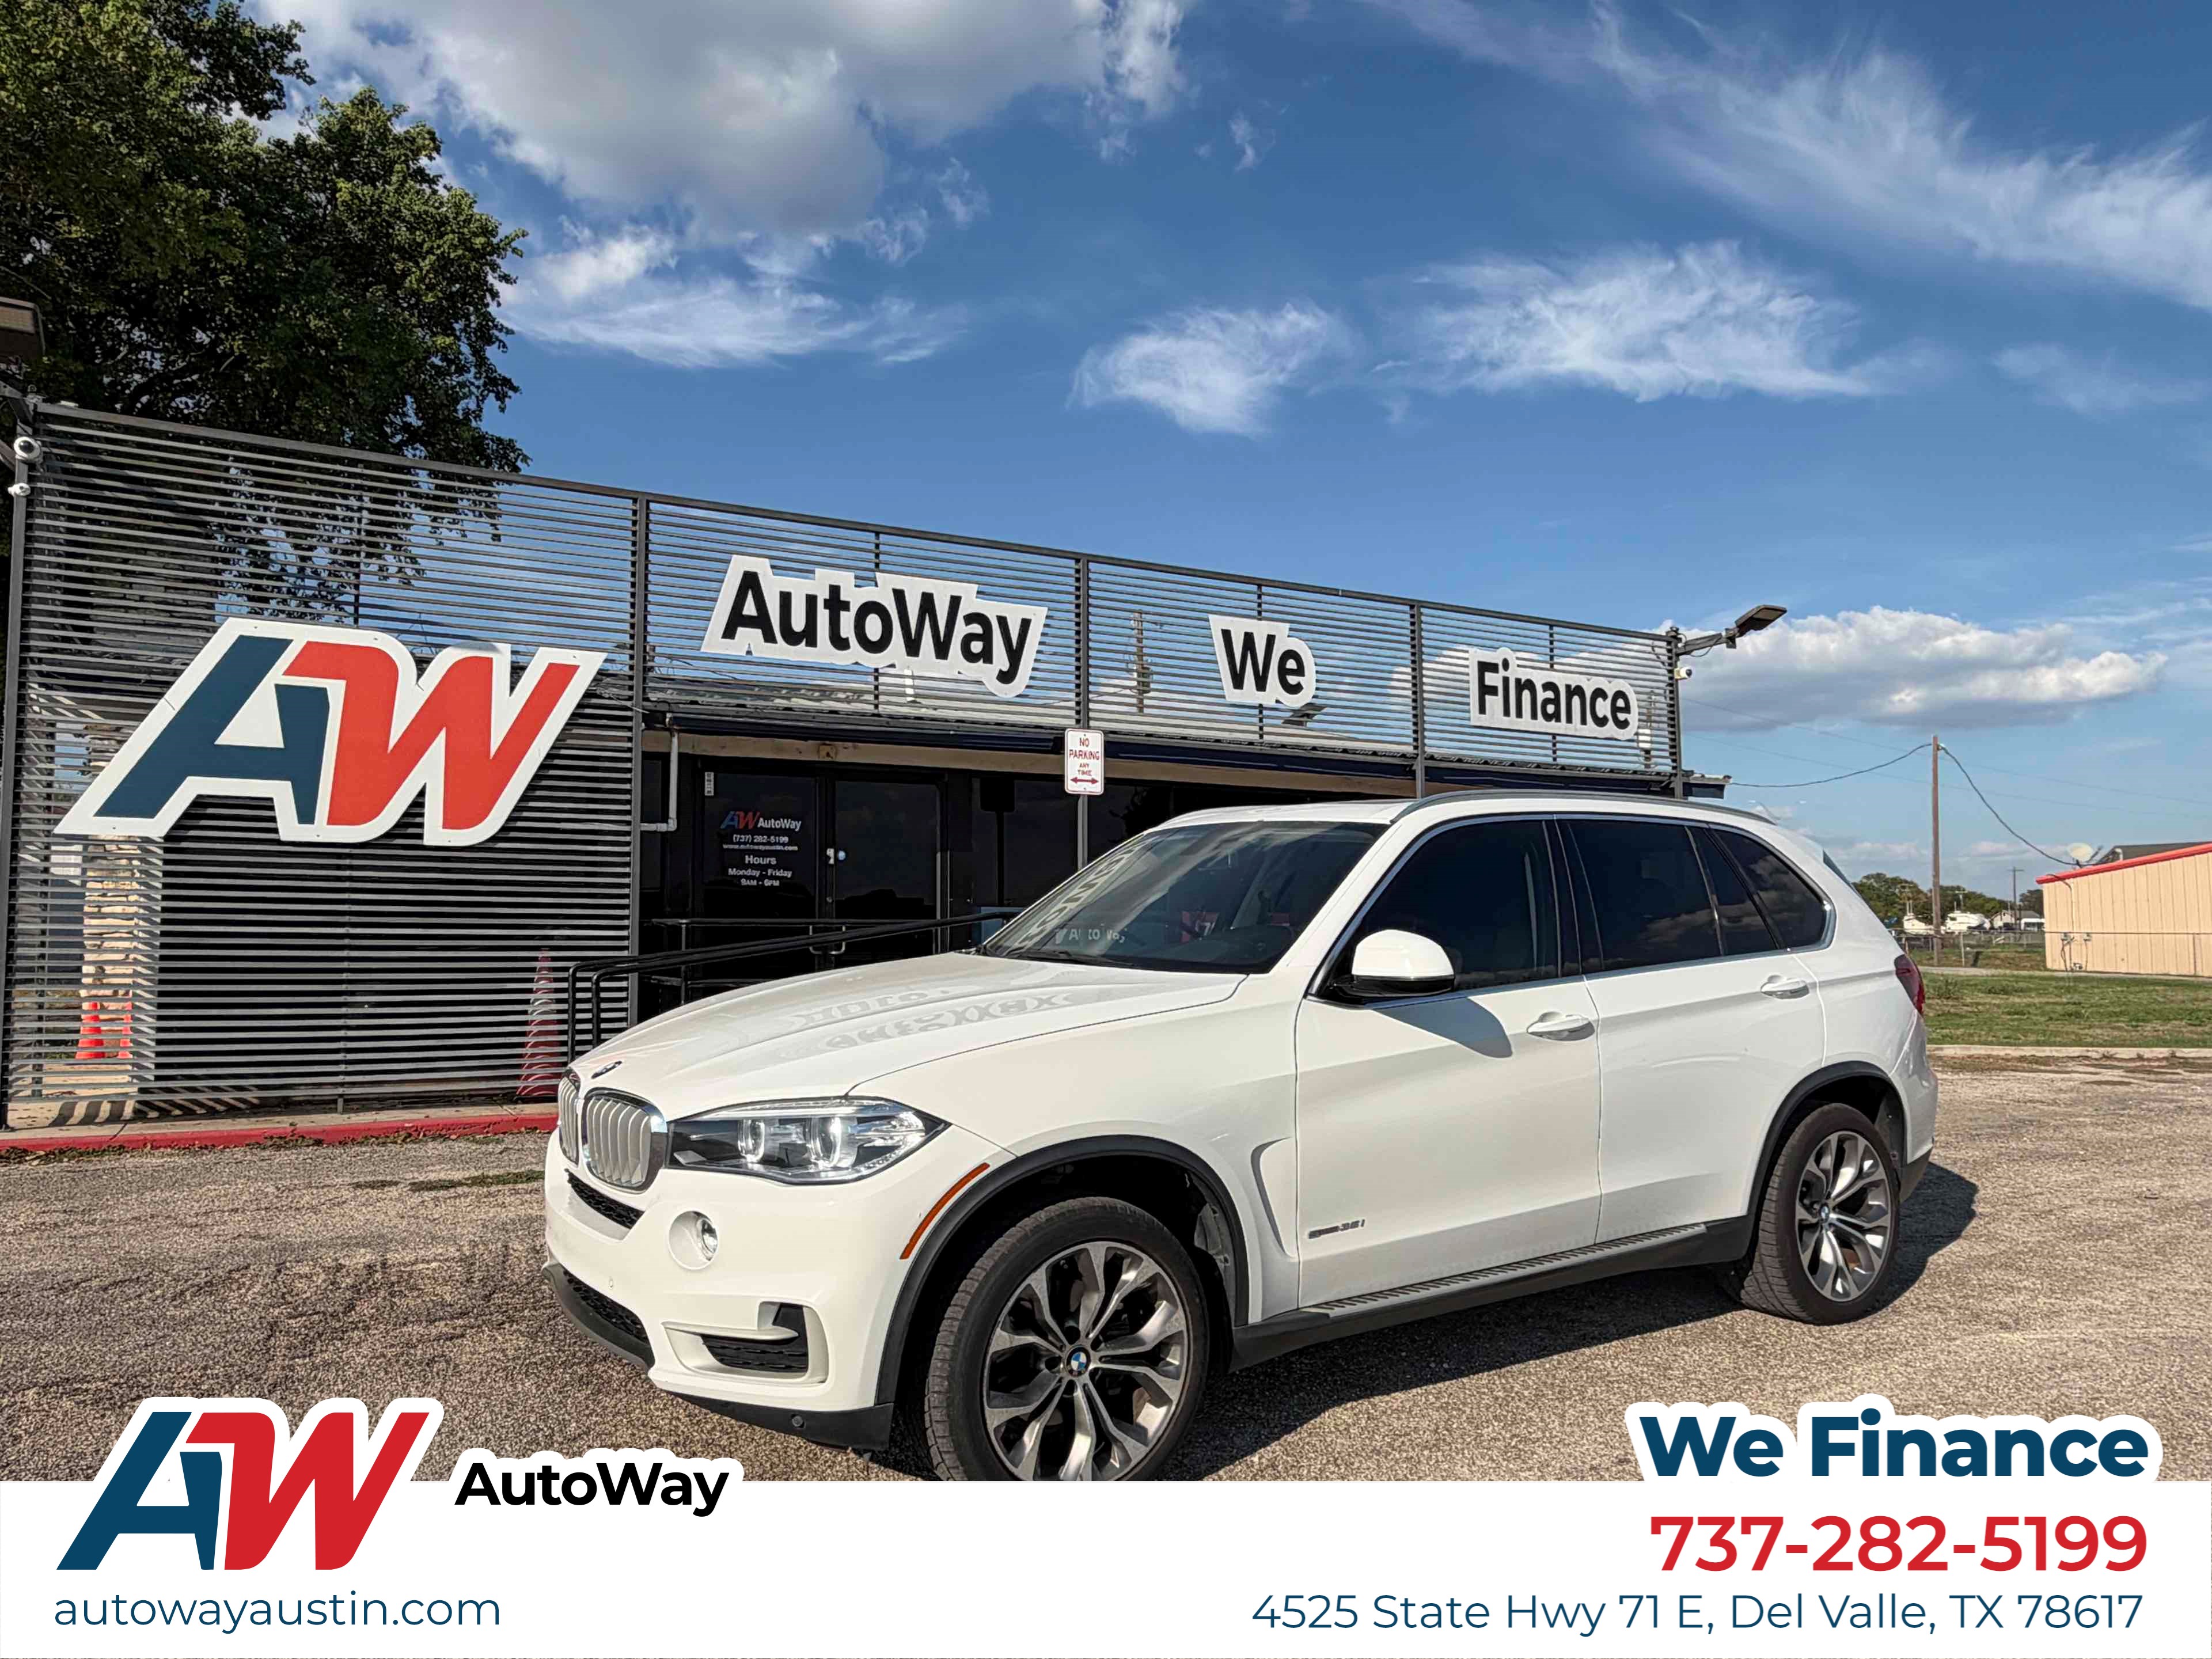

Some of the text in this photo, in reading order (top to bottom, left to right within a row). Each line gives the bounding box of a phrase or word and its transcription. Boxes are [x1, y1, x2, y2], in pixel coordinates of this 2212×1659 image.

[720, 570, 1033, 685] AutoWay
[1221, 629, 1632, 730] We Finance
[93, 634, 580, 830] AW
[1079, 738, 1090, 747] NO
[1069, 749, 1099, 761] PARKING
[757, 818, 802, 832] AutoWay
[733, 834, 789, 844] (737) 282-5199
[745, 855, 777, 865] Hours
[728, 868, 761, 878] Monday
[768, 868, 792, 878] Friday
